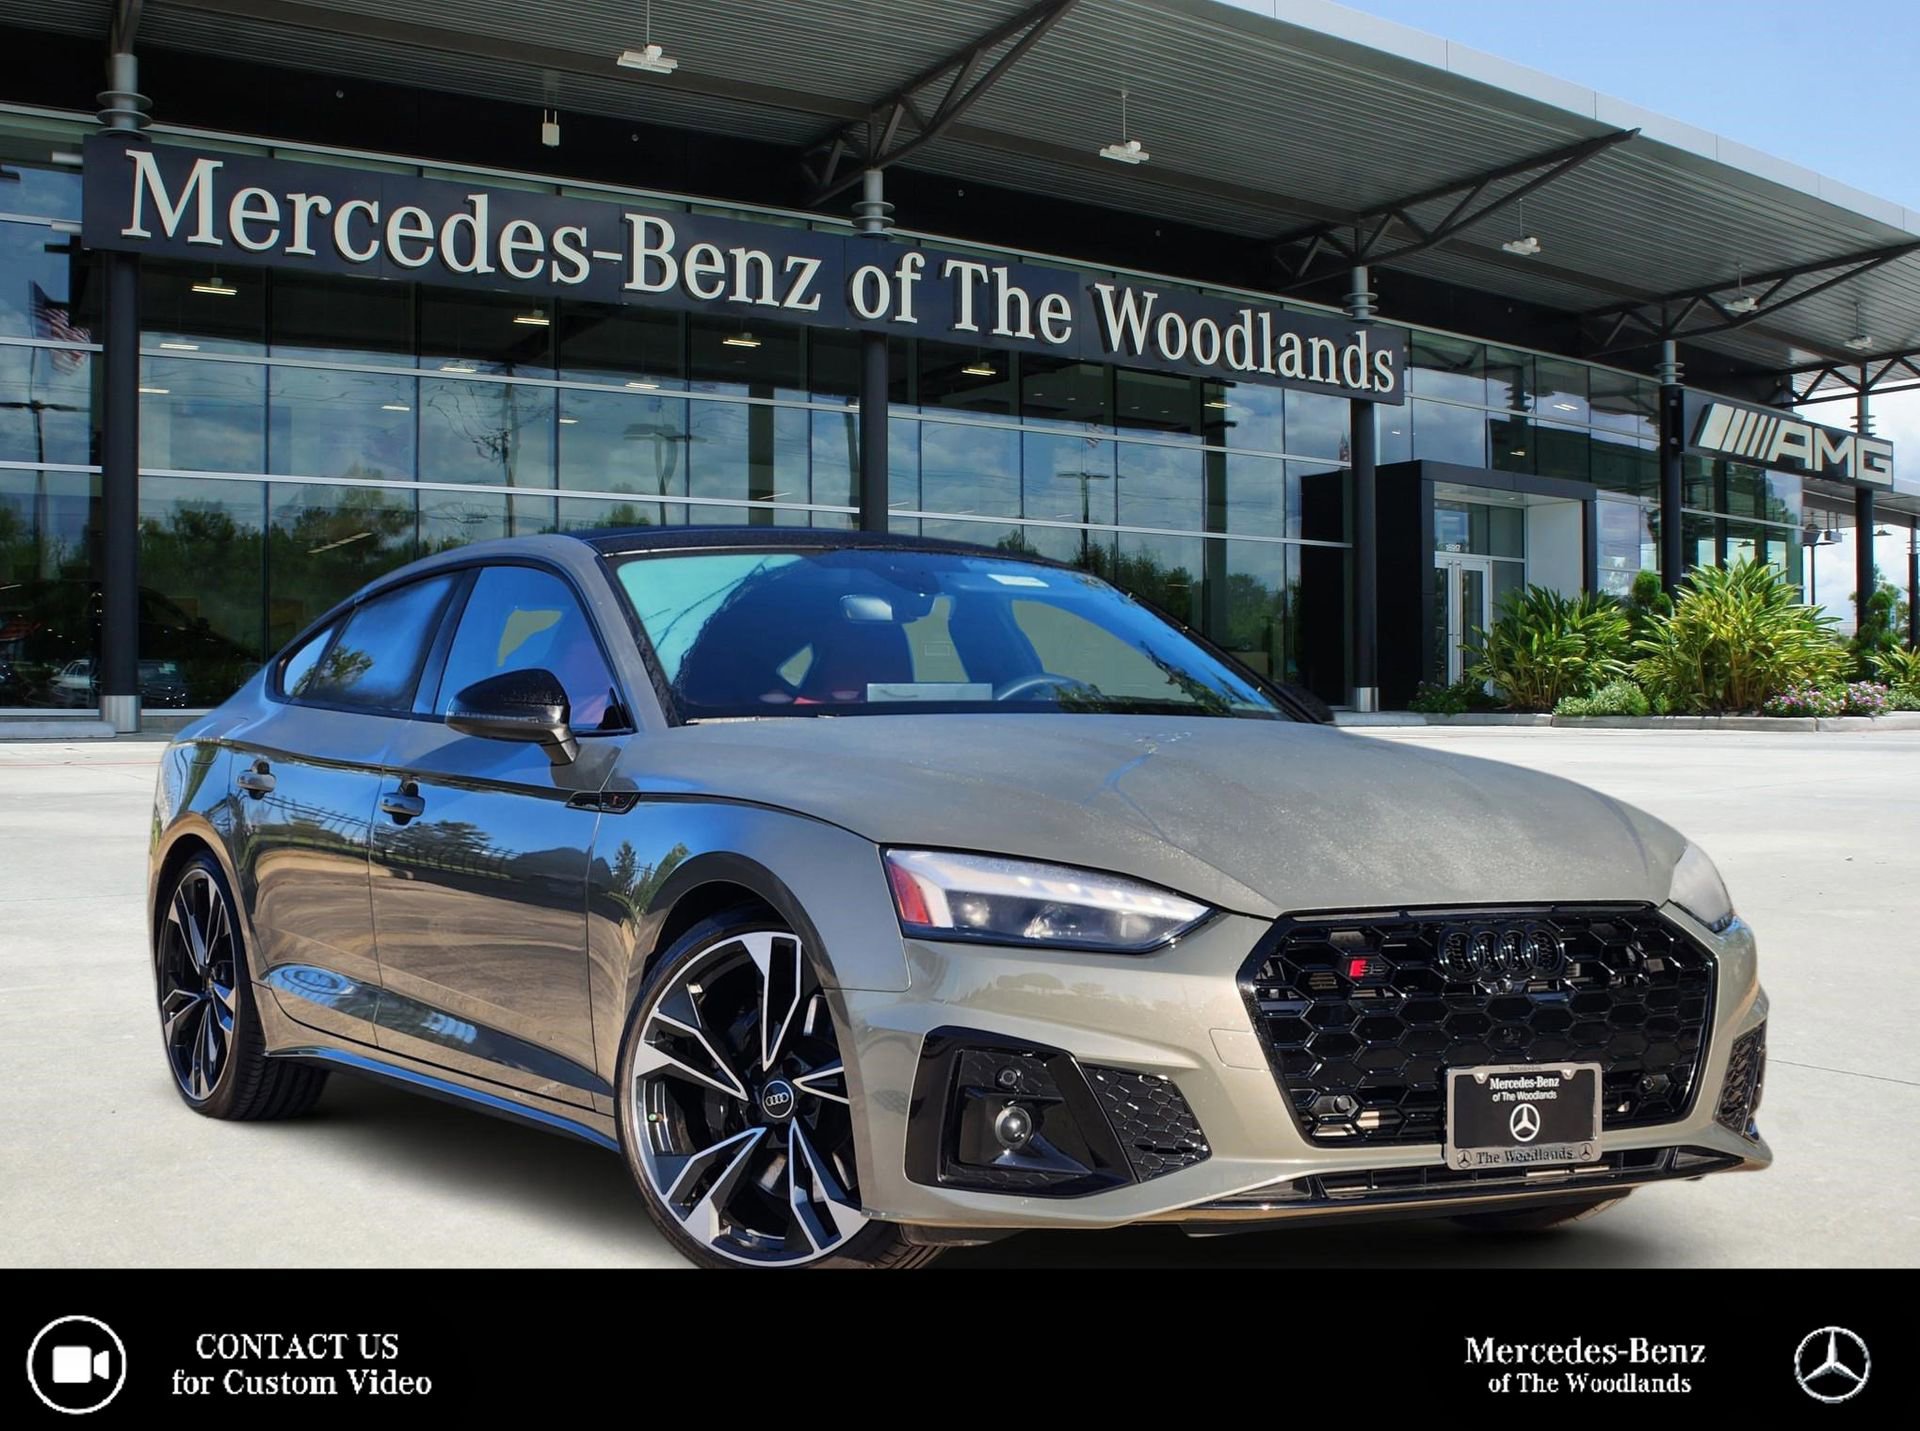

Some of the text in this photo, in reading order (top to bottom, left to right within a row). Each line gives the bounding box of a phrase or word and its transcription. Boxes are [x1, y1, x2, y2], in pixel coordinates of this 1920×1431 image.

[120, 149, 1396, 394] Mercedes-Benz of The Woodlands
[1767, 419, 1894, 486] AMG
[1489, 1075, 1560, 1090] Mercedes-Benz
[1492, 1090, 1557, 1102] of The Woodlands
[1476, 1148, 1574, 1164] The Woodlands
